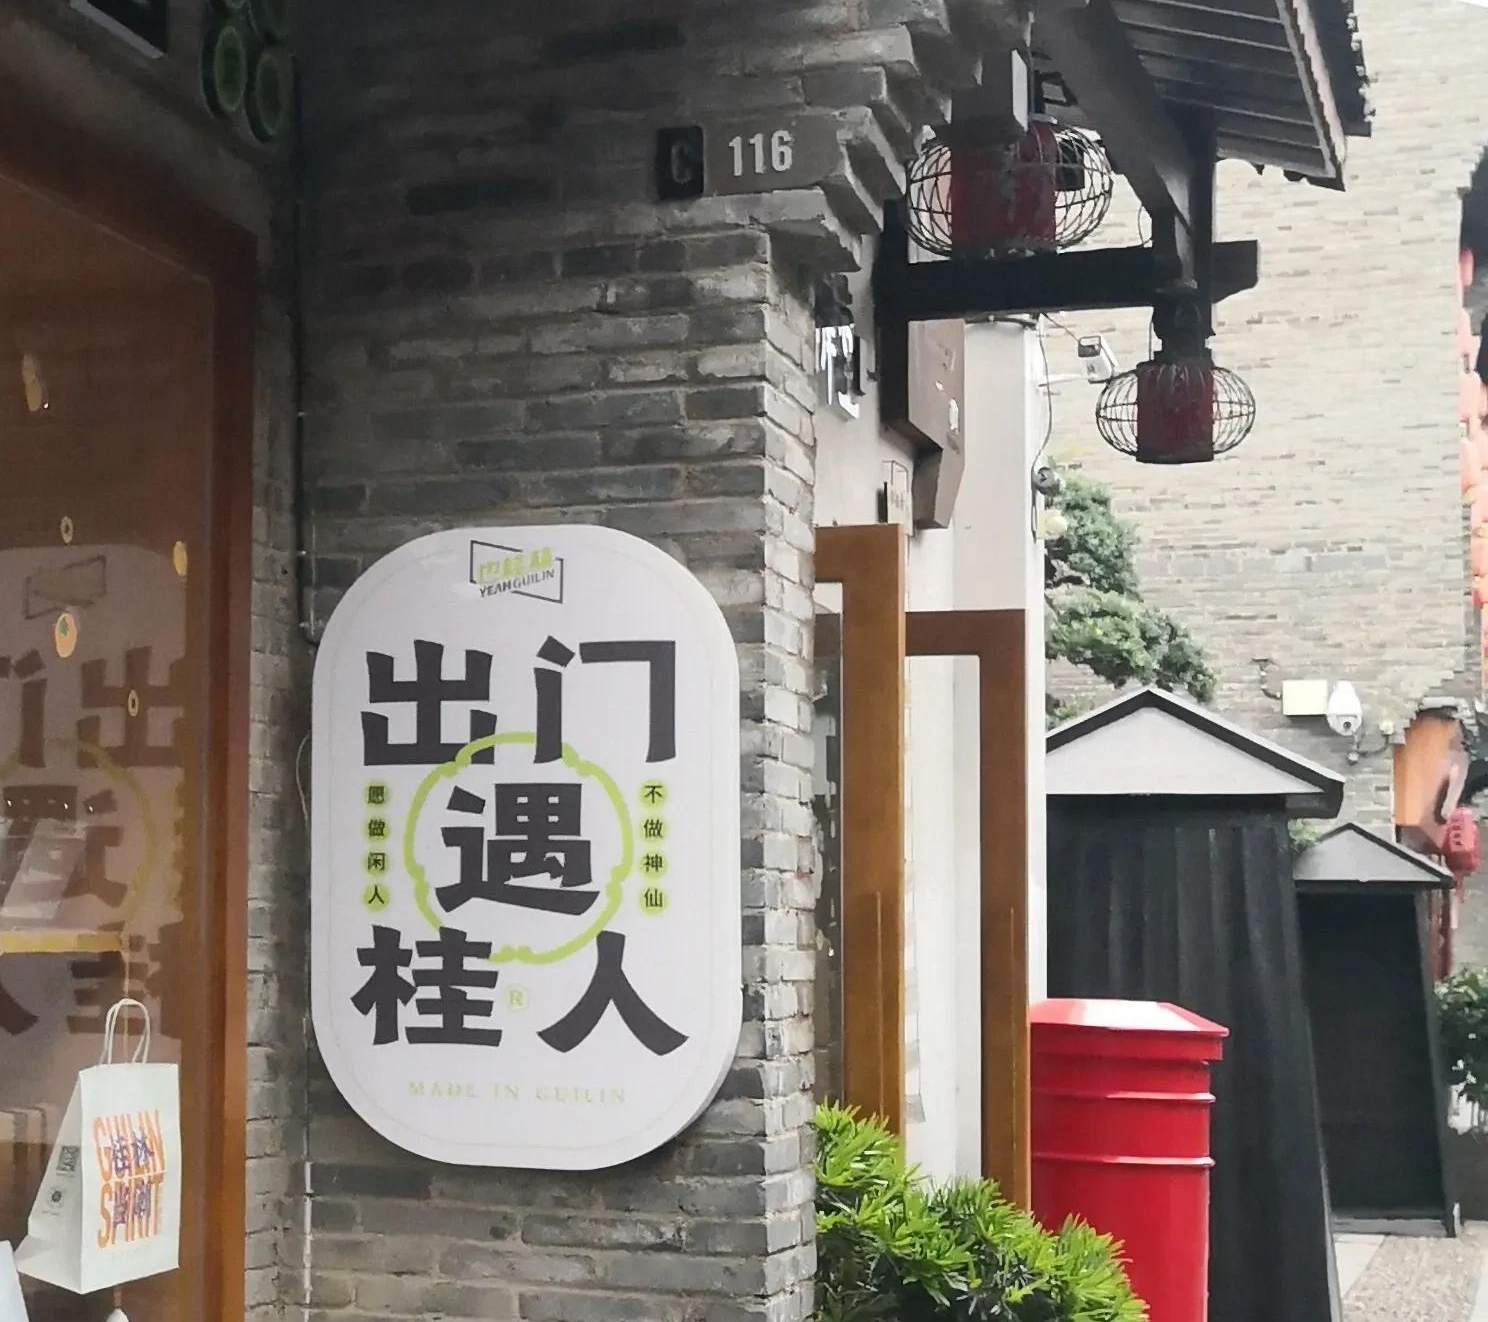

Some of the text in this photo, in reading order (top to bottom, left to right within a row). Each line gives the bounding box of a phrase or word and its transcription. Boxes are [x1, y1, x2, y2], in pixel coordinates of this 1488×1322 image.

[728, 129, 793, 176] 116
[360, 635, 676, 766] 出门
[367, 785, 386, 904] 愿做闲人
[436, 782, 600, 916] 遇
[643, 785, 663, 908] 不做神仙
[350, 924, 690, 1056] 桂人
